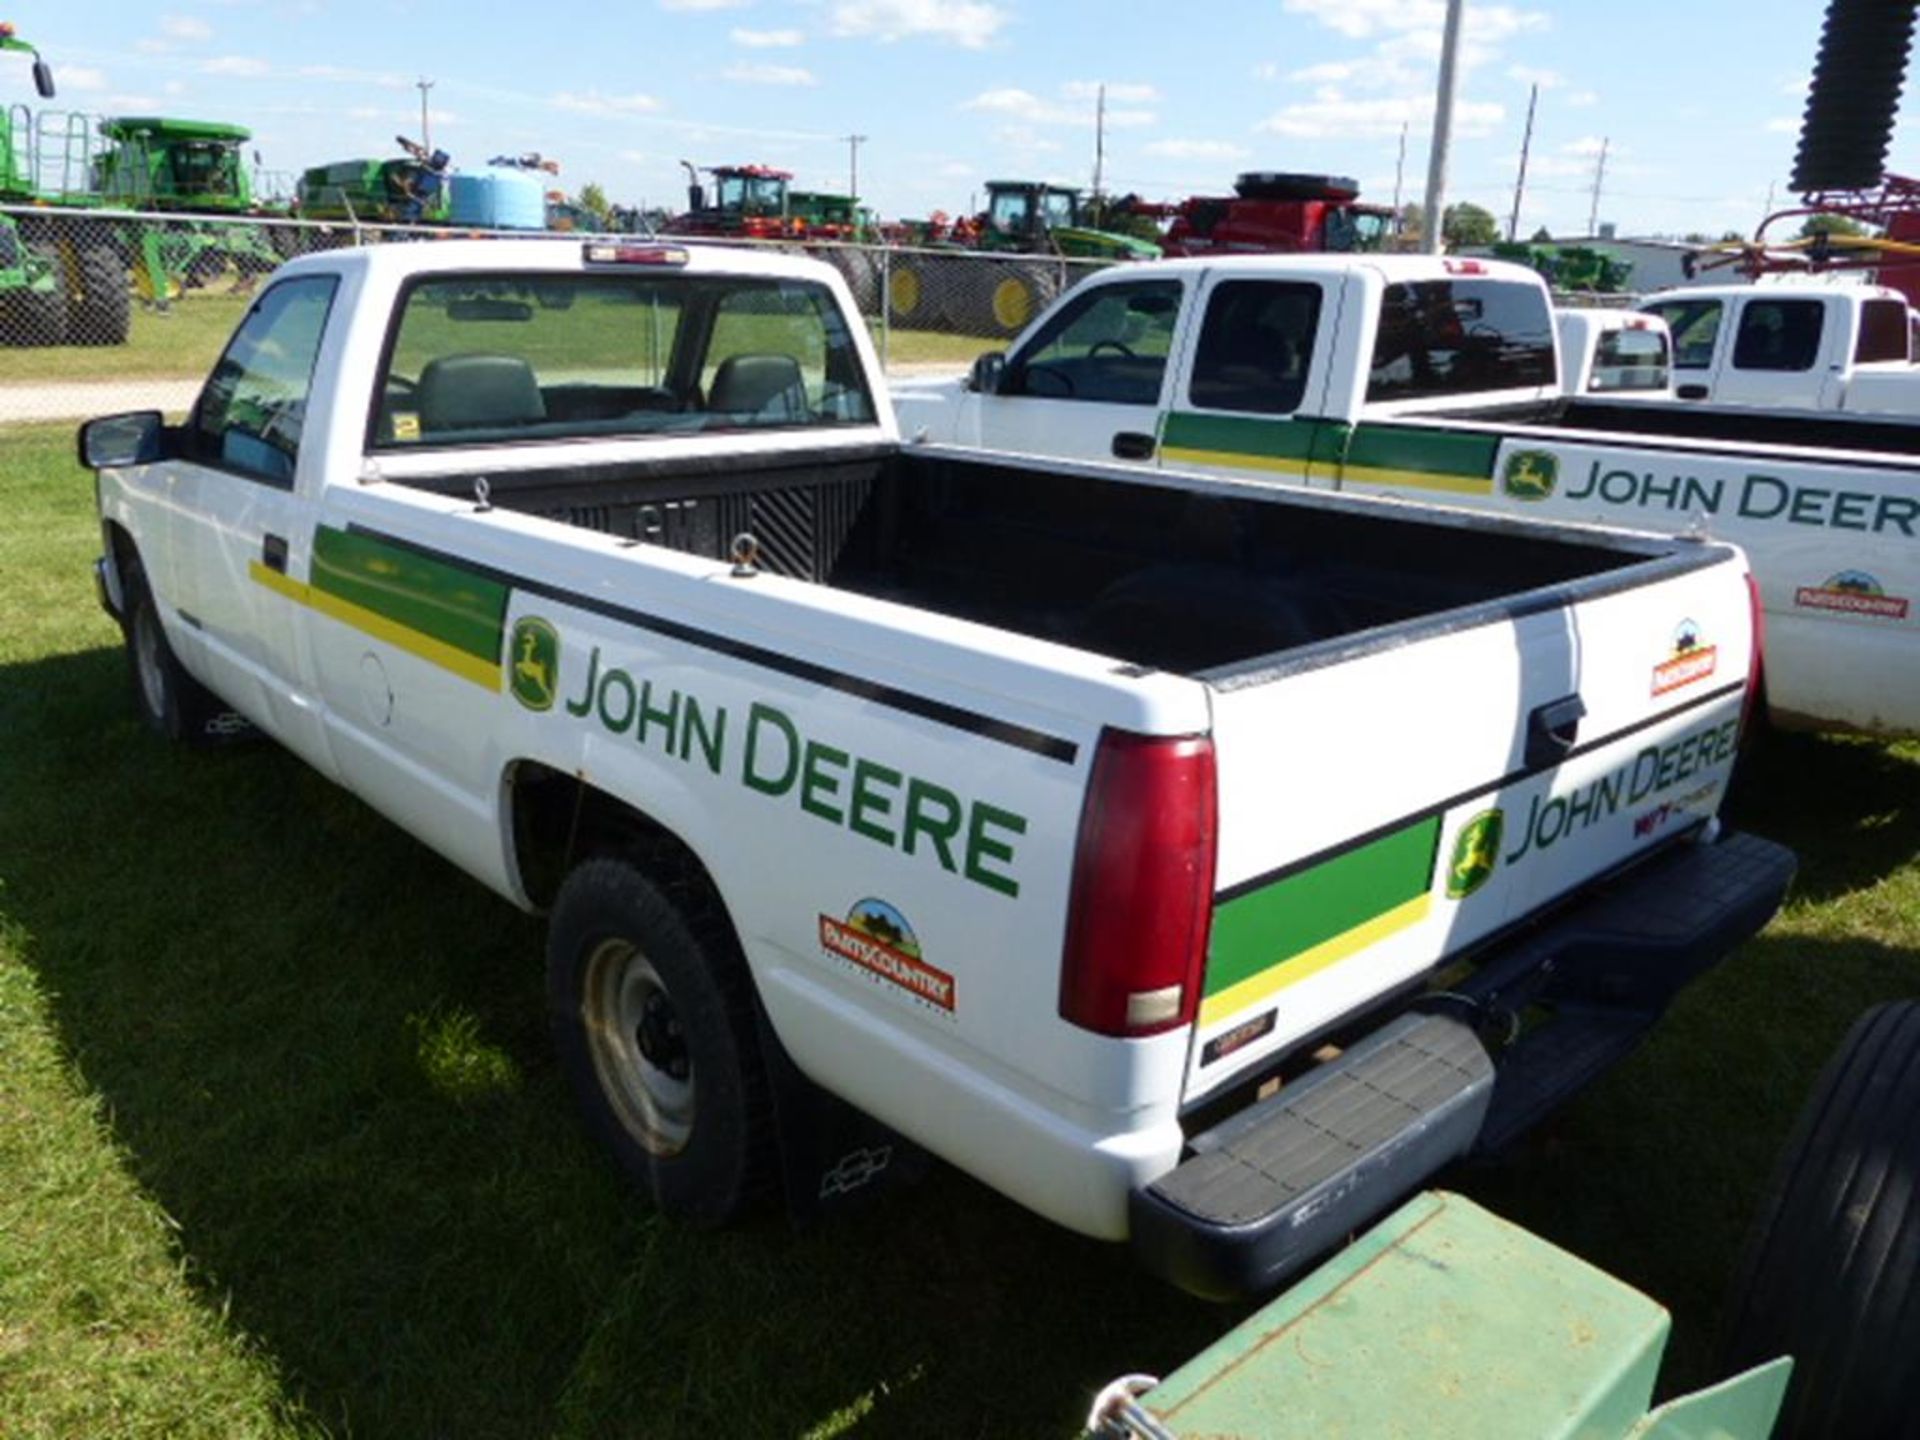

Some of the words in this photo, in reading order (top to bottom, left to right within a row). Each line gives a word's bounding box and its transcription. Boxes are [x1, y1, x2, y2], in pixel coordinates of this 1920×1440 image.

[1566, 460, 1725, 514] JOHN
[566, 646, 727, 775] JOHN
[741, 701, 1027, 899] DEERE
[1505, 768, 1626, 866] JOHN
[1627, 718, 1739, 806] DEERE
